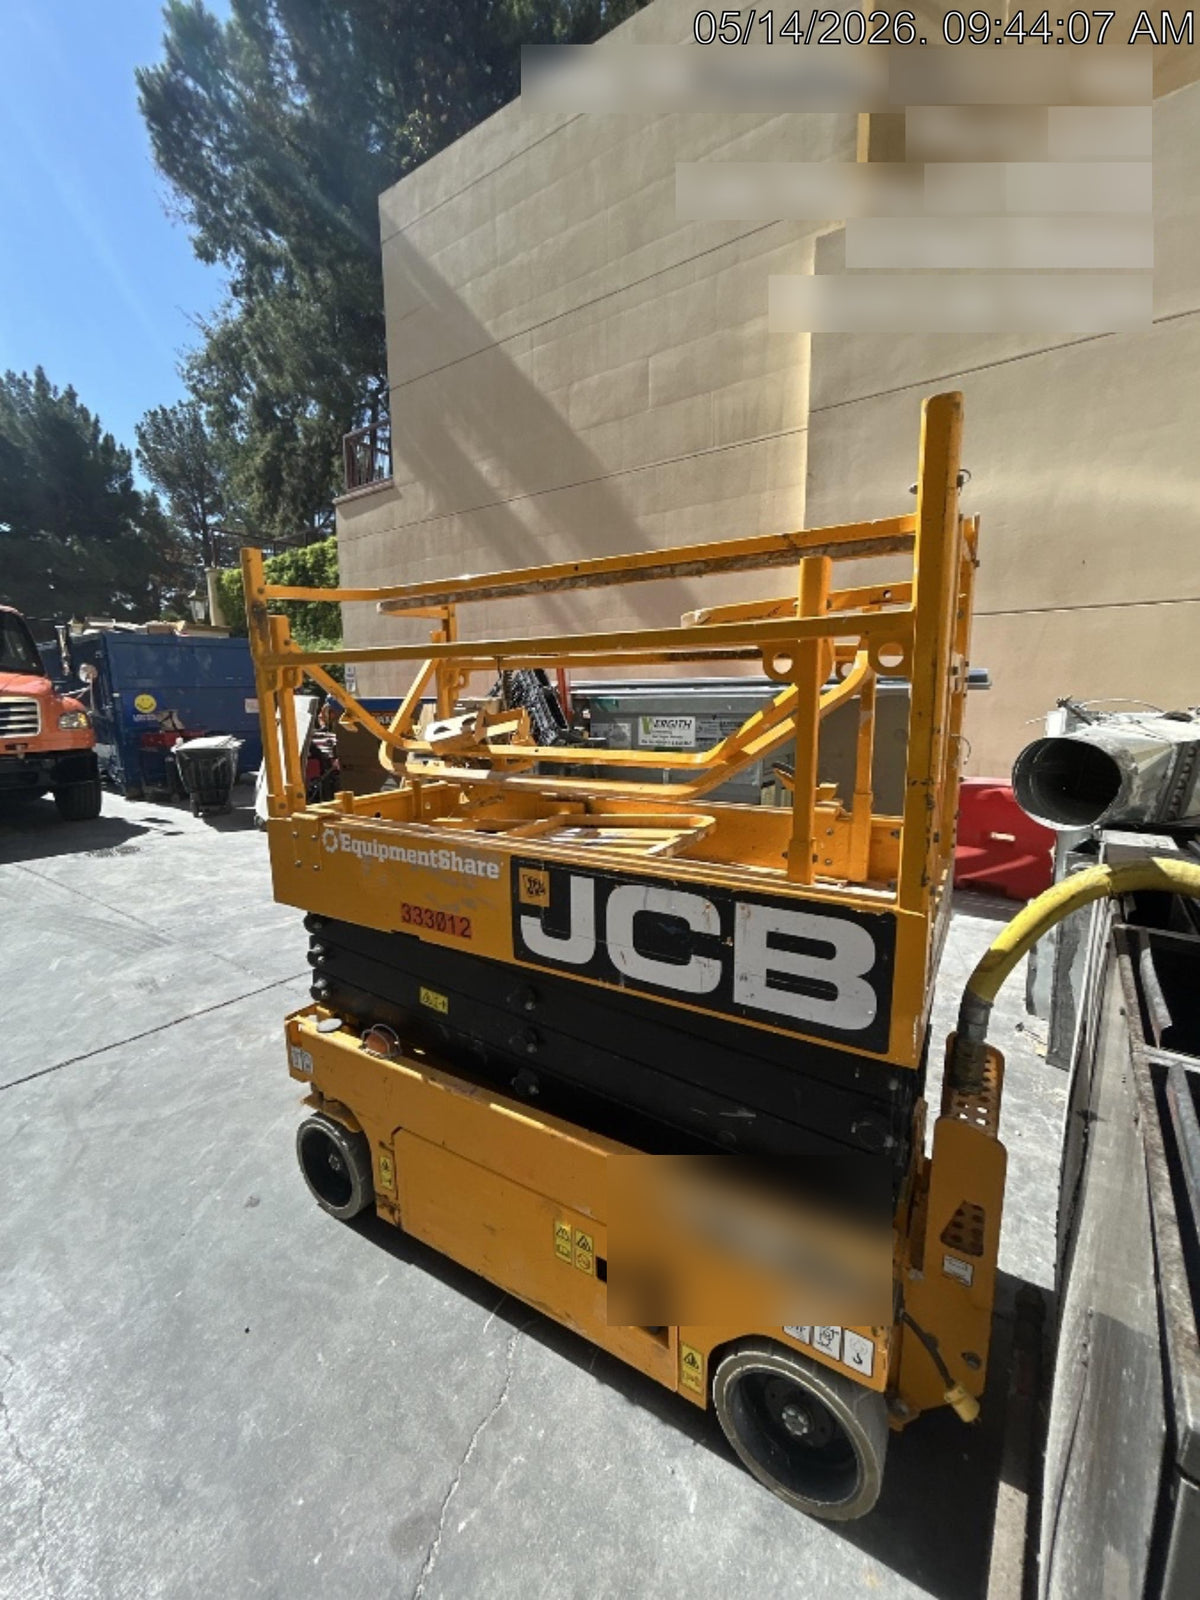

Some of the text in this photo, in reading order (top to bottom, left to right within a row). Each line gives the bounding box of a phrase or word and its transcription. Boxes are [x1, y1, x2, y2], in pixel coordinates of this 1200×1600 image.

[339, 832, 500, 880] EquipmentShare
[401, 902, 472, 939] 333012
[520, 875, 878, 1031] JCB
